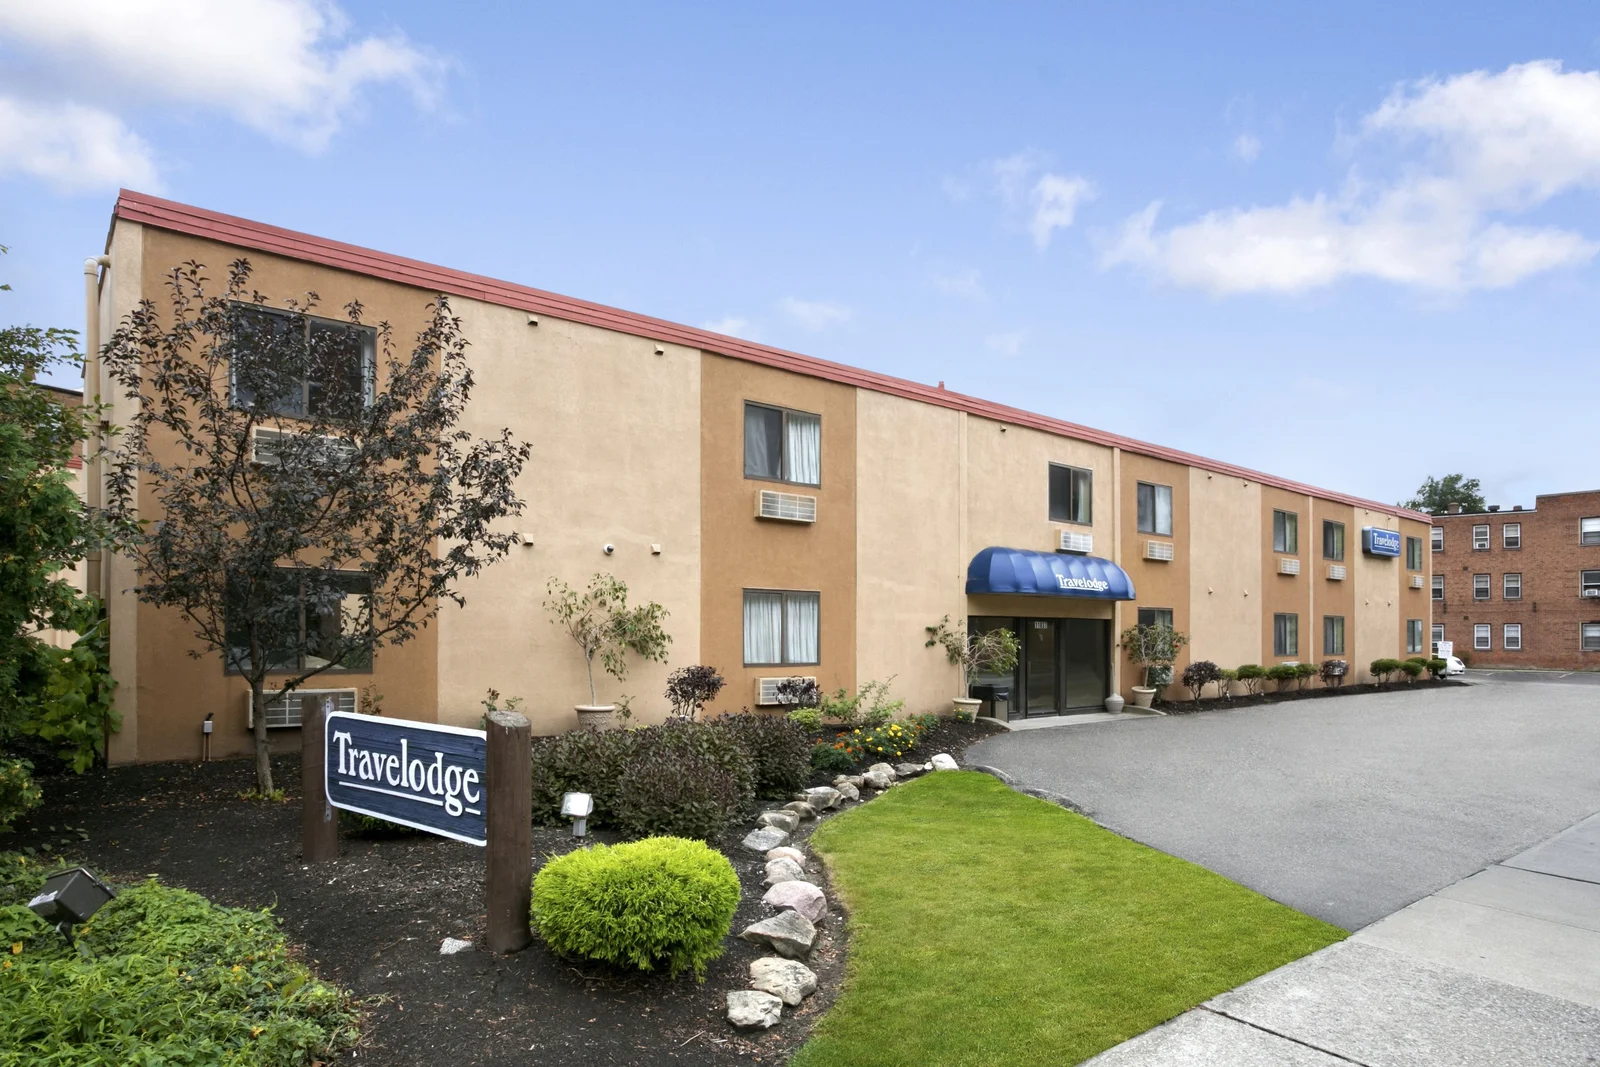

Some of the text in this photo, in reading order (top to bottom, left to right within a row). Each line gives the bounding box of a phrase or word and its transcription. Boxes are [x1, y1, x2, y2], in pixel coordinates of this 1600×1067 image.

[1373, 533, 1400, 551] Travelodge
[1056, 574, 1109, 591] Travelodge
[333, 731, 480, 817] Travelodge
